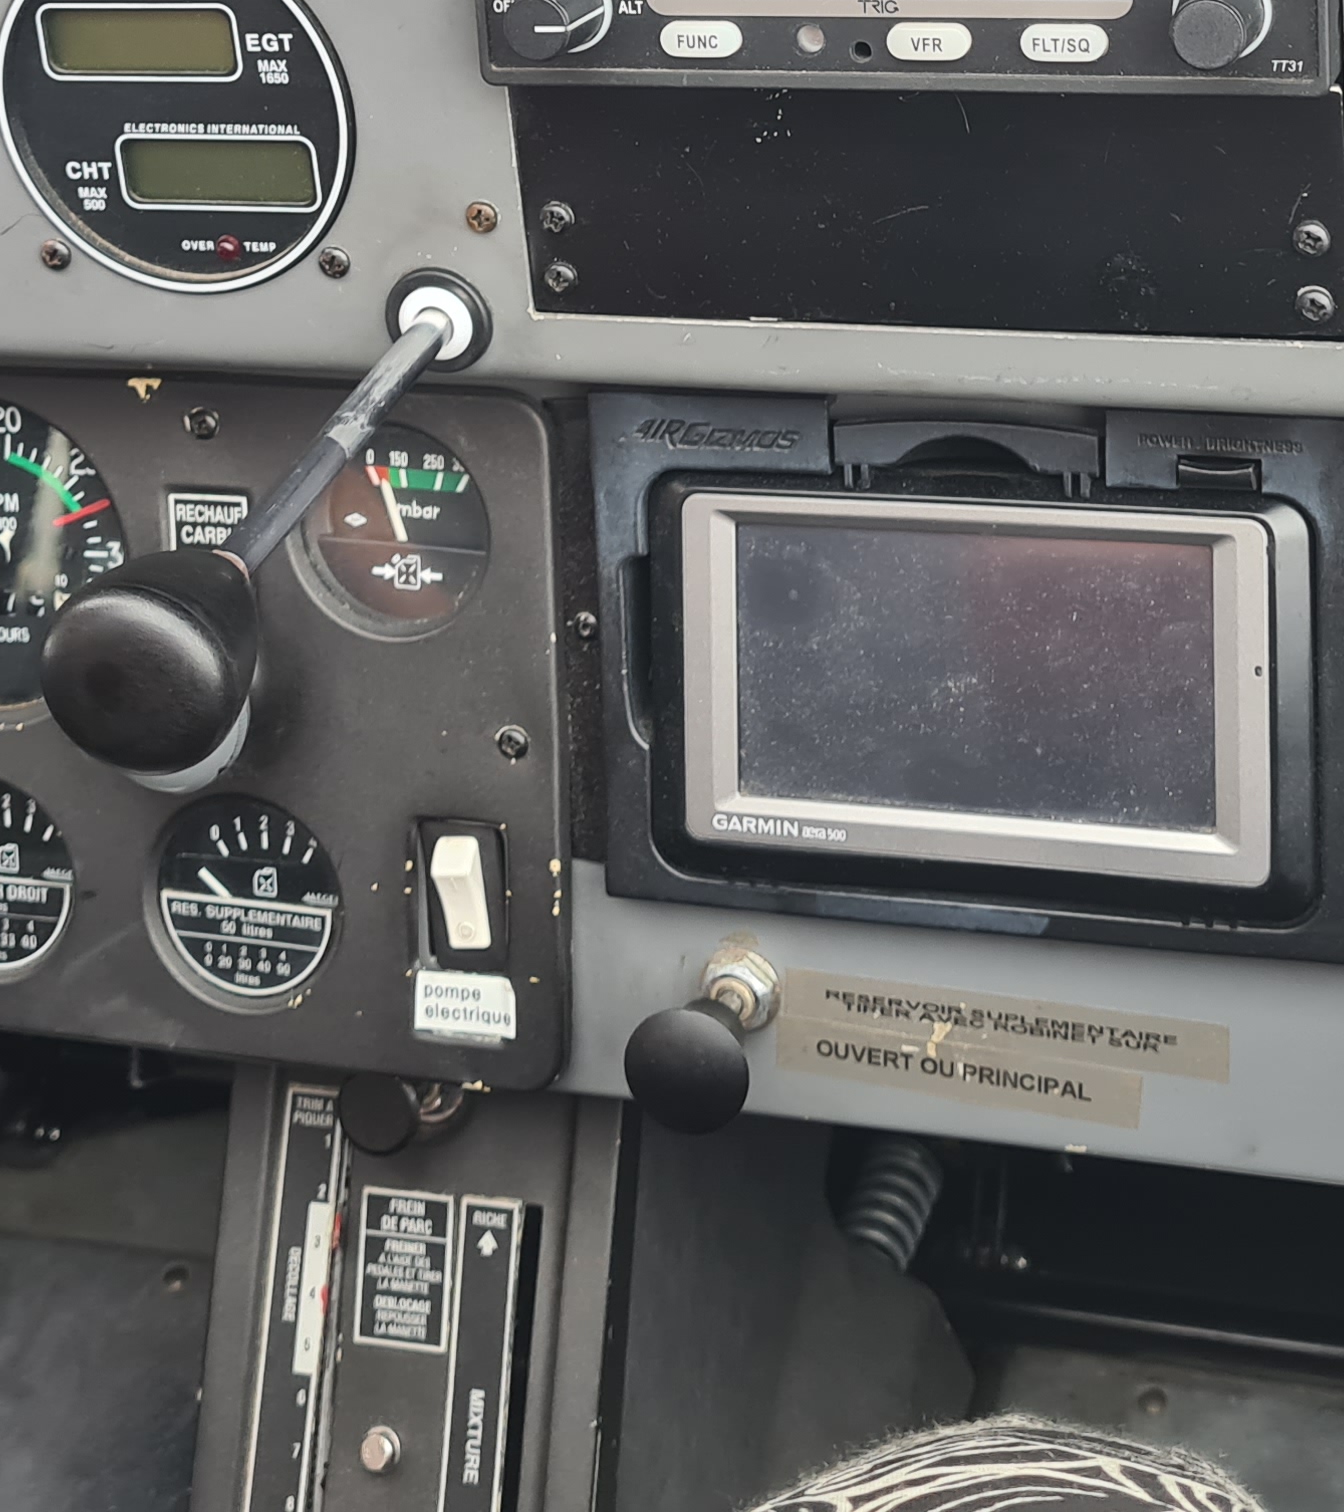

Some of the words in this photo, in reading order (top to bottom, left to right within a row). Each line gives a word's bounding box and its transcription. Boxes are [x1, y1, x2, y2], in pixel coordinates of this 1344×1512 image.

[618, 0, 644, 15] ALT
[244, 32, 294, 53] EGT
[676, 34, 719, 49] FUNC
[910, 37, 943, 53] VFR
[1031, 37, 1091, 55] FLT/SQ
[257, 59, 288, 73] MAX
[259, 71, 290, 85] 1650
[123, 122, 205, 134] ELECTRONICS
[206, 123, 301, 135] INTERNATIONAL
[65, 161, 112, 181] CHT
[181, 240, 215, 252] OVER
[243, 240, 277, 253] TEMP
[423, 454, 445, 470] 250
[6, 884, 48, 904] DROIT
[424, 983, 481, 1002] pompe
[425, 1003, 512, 1026] electrique
[816, 1039, 913, 1072] OUVERT
[920, 1056, 955, 1079] OU
[961, 1063, 1092, 1102] PRINCIPAL
[389, 1198, 426, 1214] FREIN
[381, 1214, 399, 1232] DE
[400, 1217, 433, 1235] PARC
[462, 1388, 485, 1486] MIXTURE
